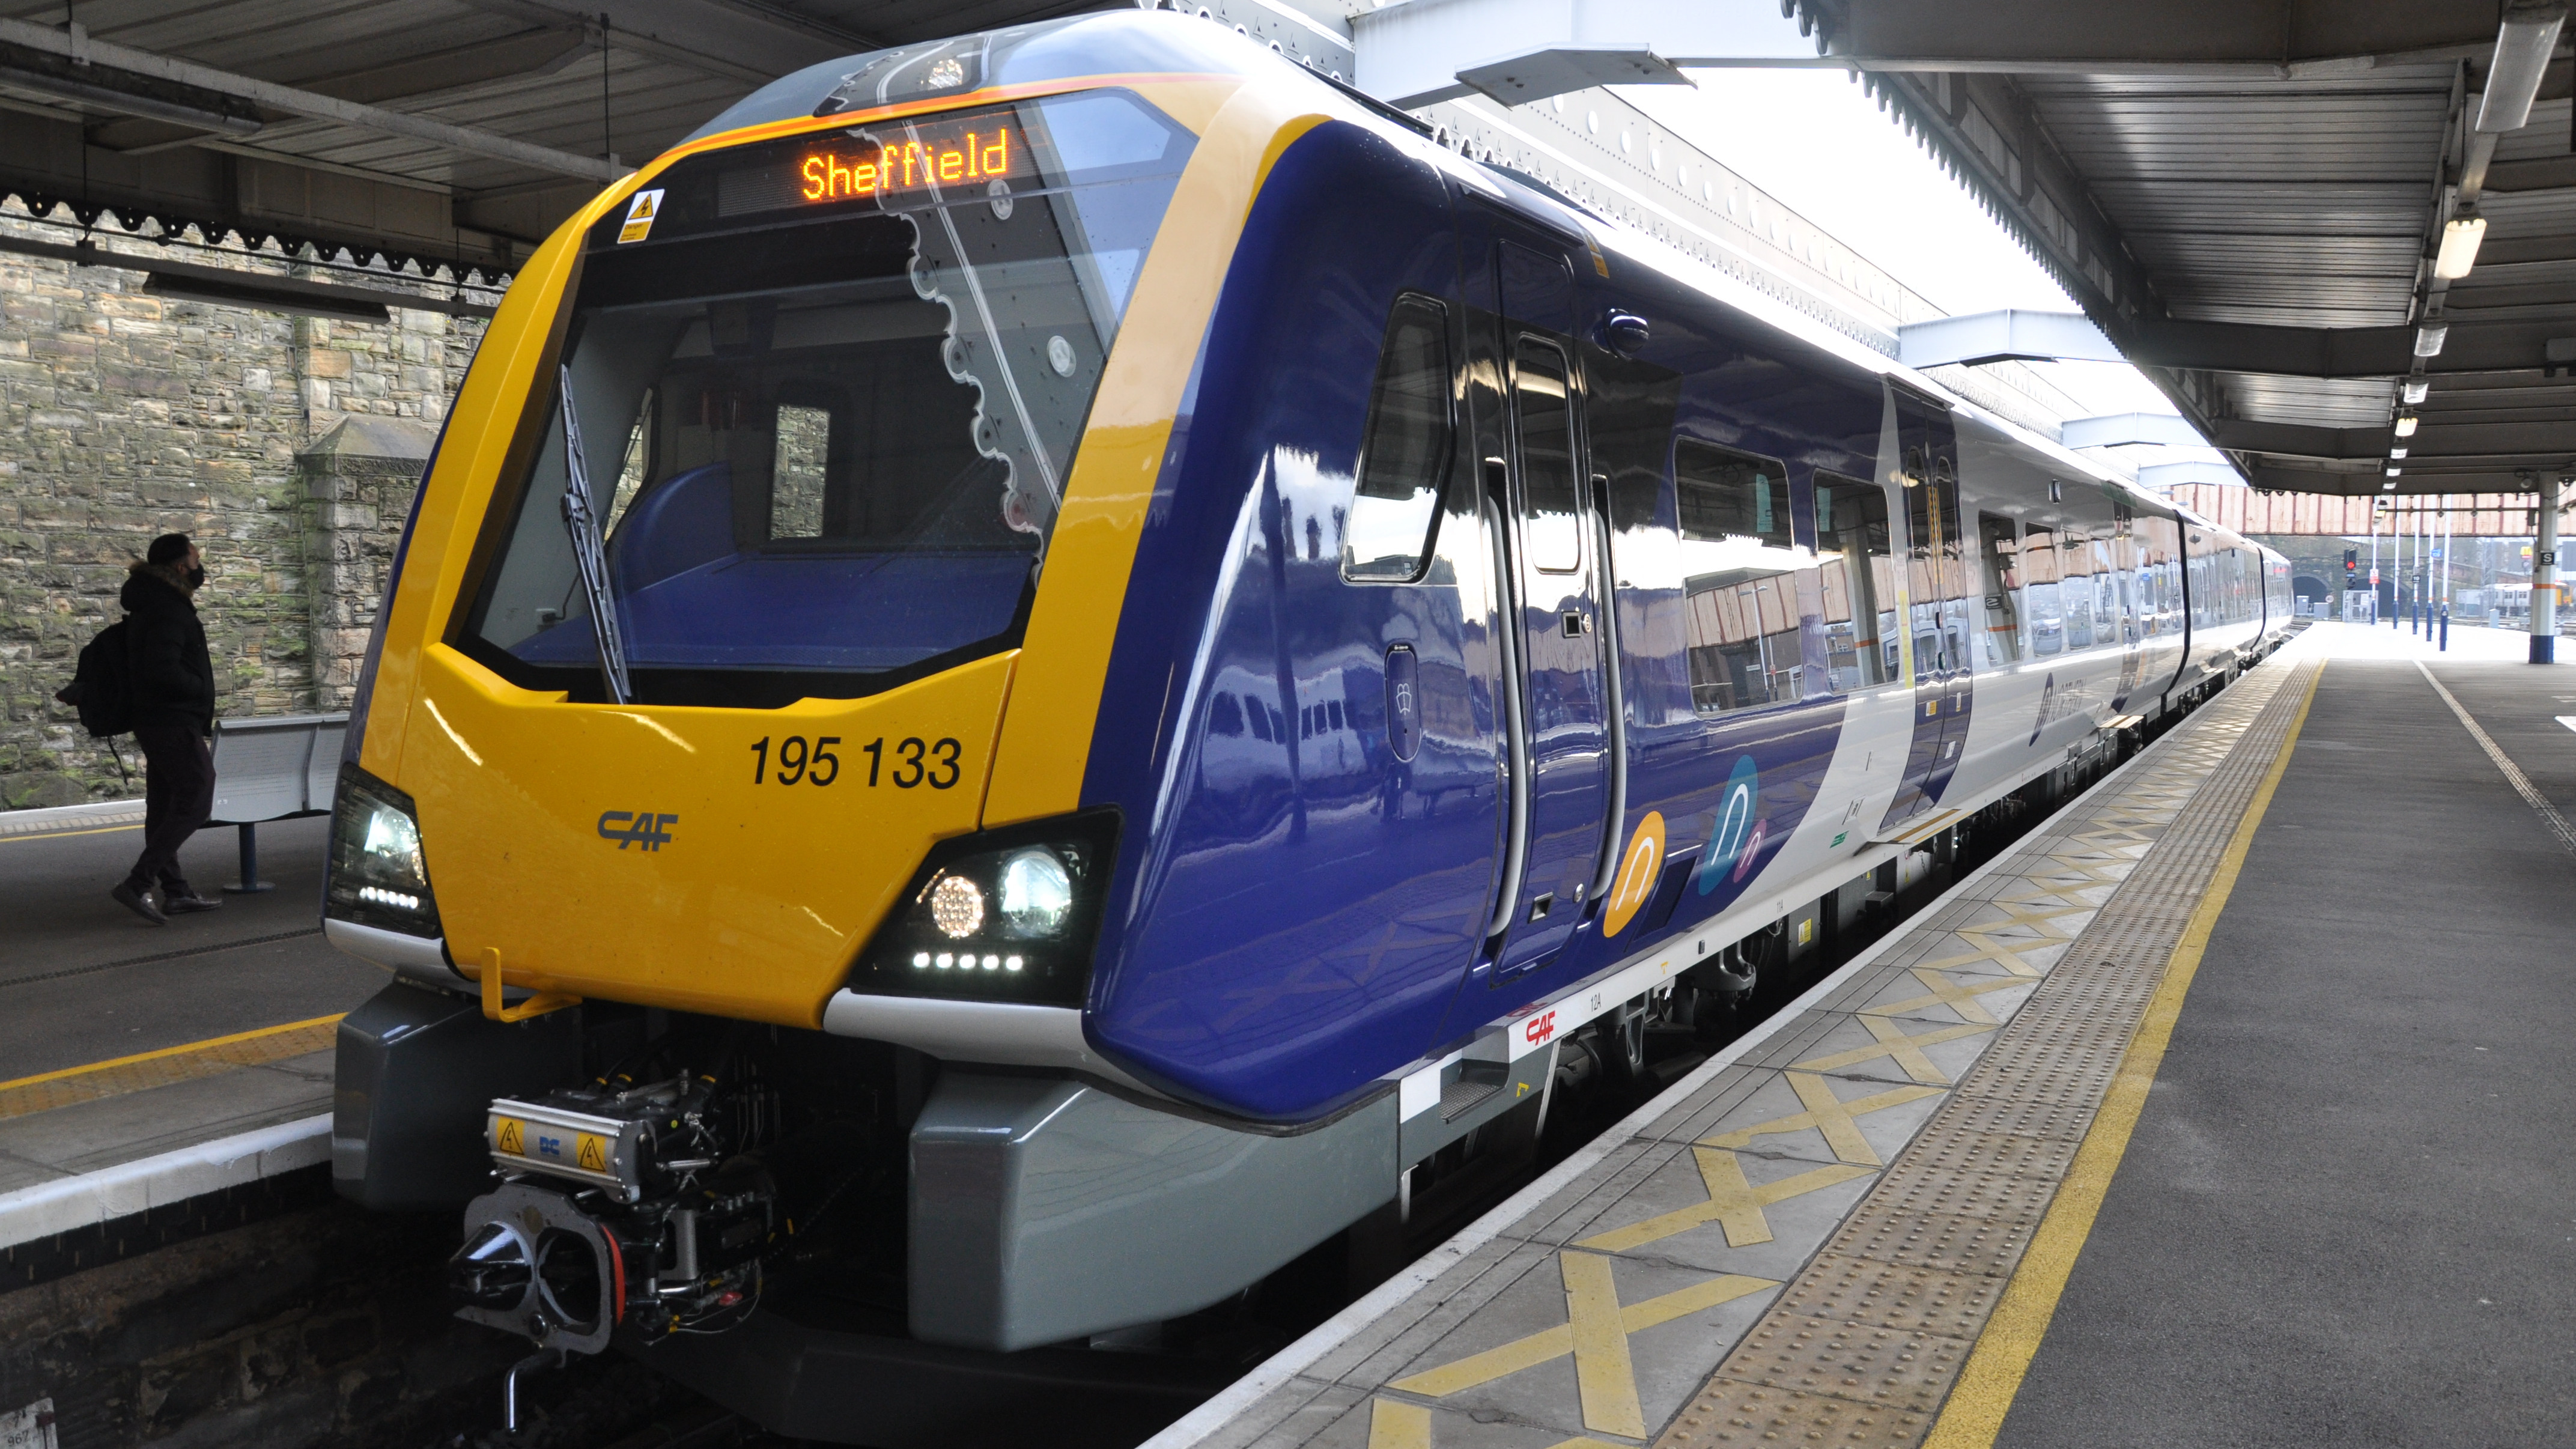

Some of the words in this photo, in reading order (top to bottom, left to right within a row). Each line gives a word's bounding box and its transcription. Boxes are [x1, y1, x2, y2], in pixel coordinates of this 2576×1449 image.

[803, 128, 1007, 199] Sheffield
[2543, 553, 2553, 562] S
[750, 736, 841, 786] 195
[863, 737, 962, 789] 133
[597, 811, 679, 852] CAF
[1591, 992, 1601, 1012] 12A
[1526, 1010, 1556, 1046] CAF
